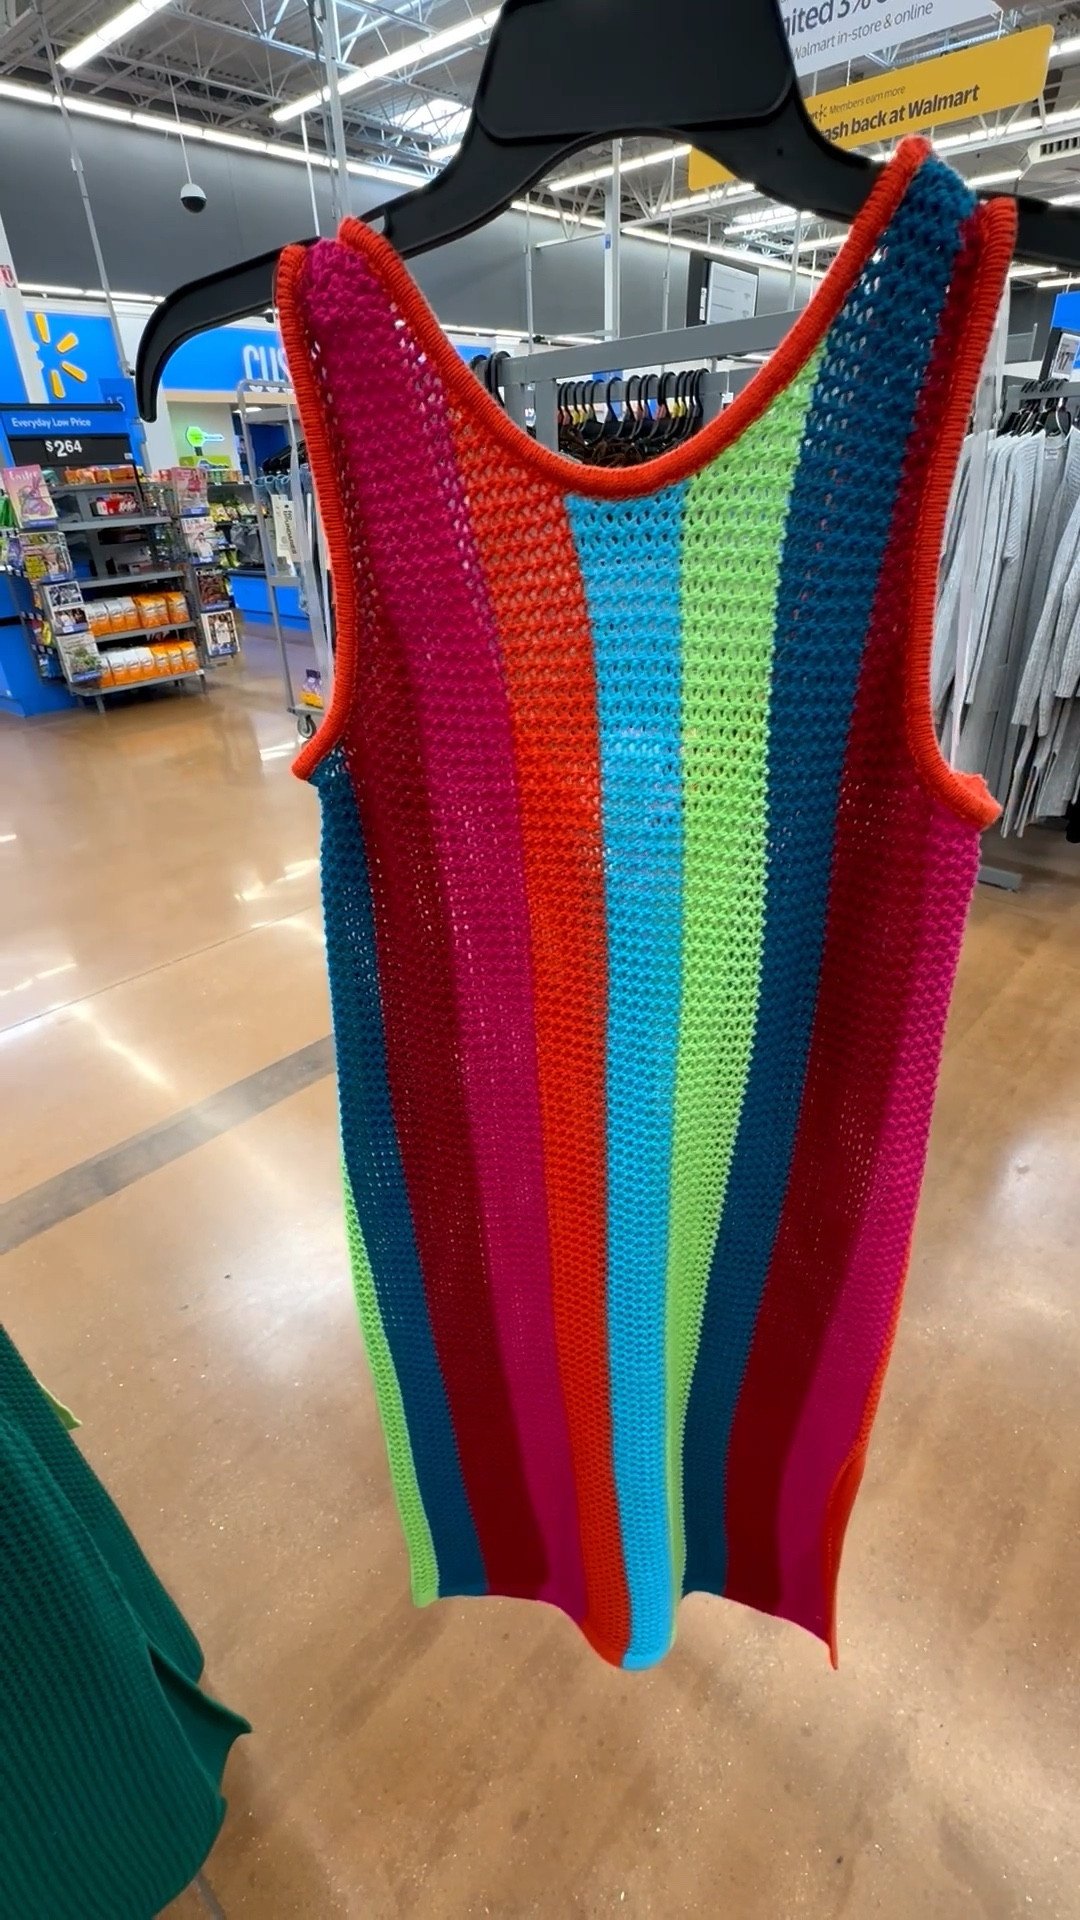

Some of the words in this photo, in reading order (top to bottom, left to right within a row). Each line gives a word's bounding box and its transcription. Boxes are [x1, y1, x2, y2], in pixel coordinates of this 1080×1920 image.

[837, 20, 881, 44] in-store
[883, 13, 892, 29] &
[894, 2, 934, 26] online
[829, 99, 864, 114] Members
[865, 91, 884, 105] earn
[884, 86, 906, 99] more
[851, 110, 886, 135] back
[888, 105, 906, 124] at
[908, 84, 980, 119] Walmart
[11, 417, 51, 430] Everyday
[52, 418, 69, 428] Low
[70, 417, 91, 428] Price
